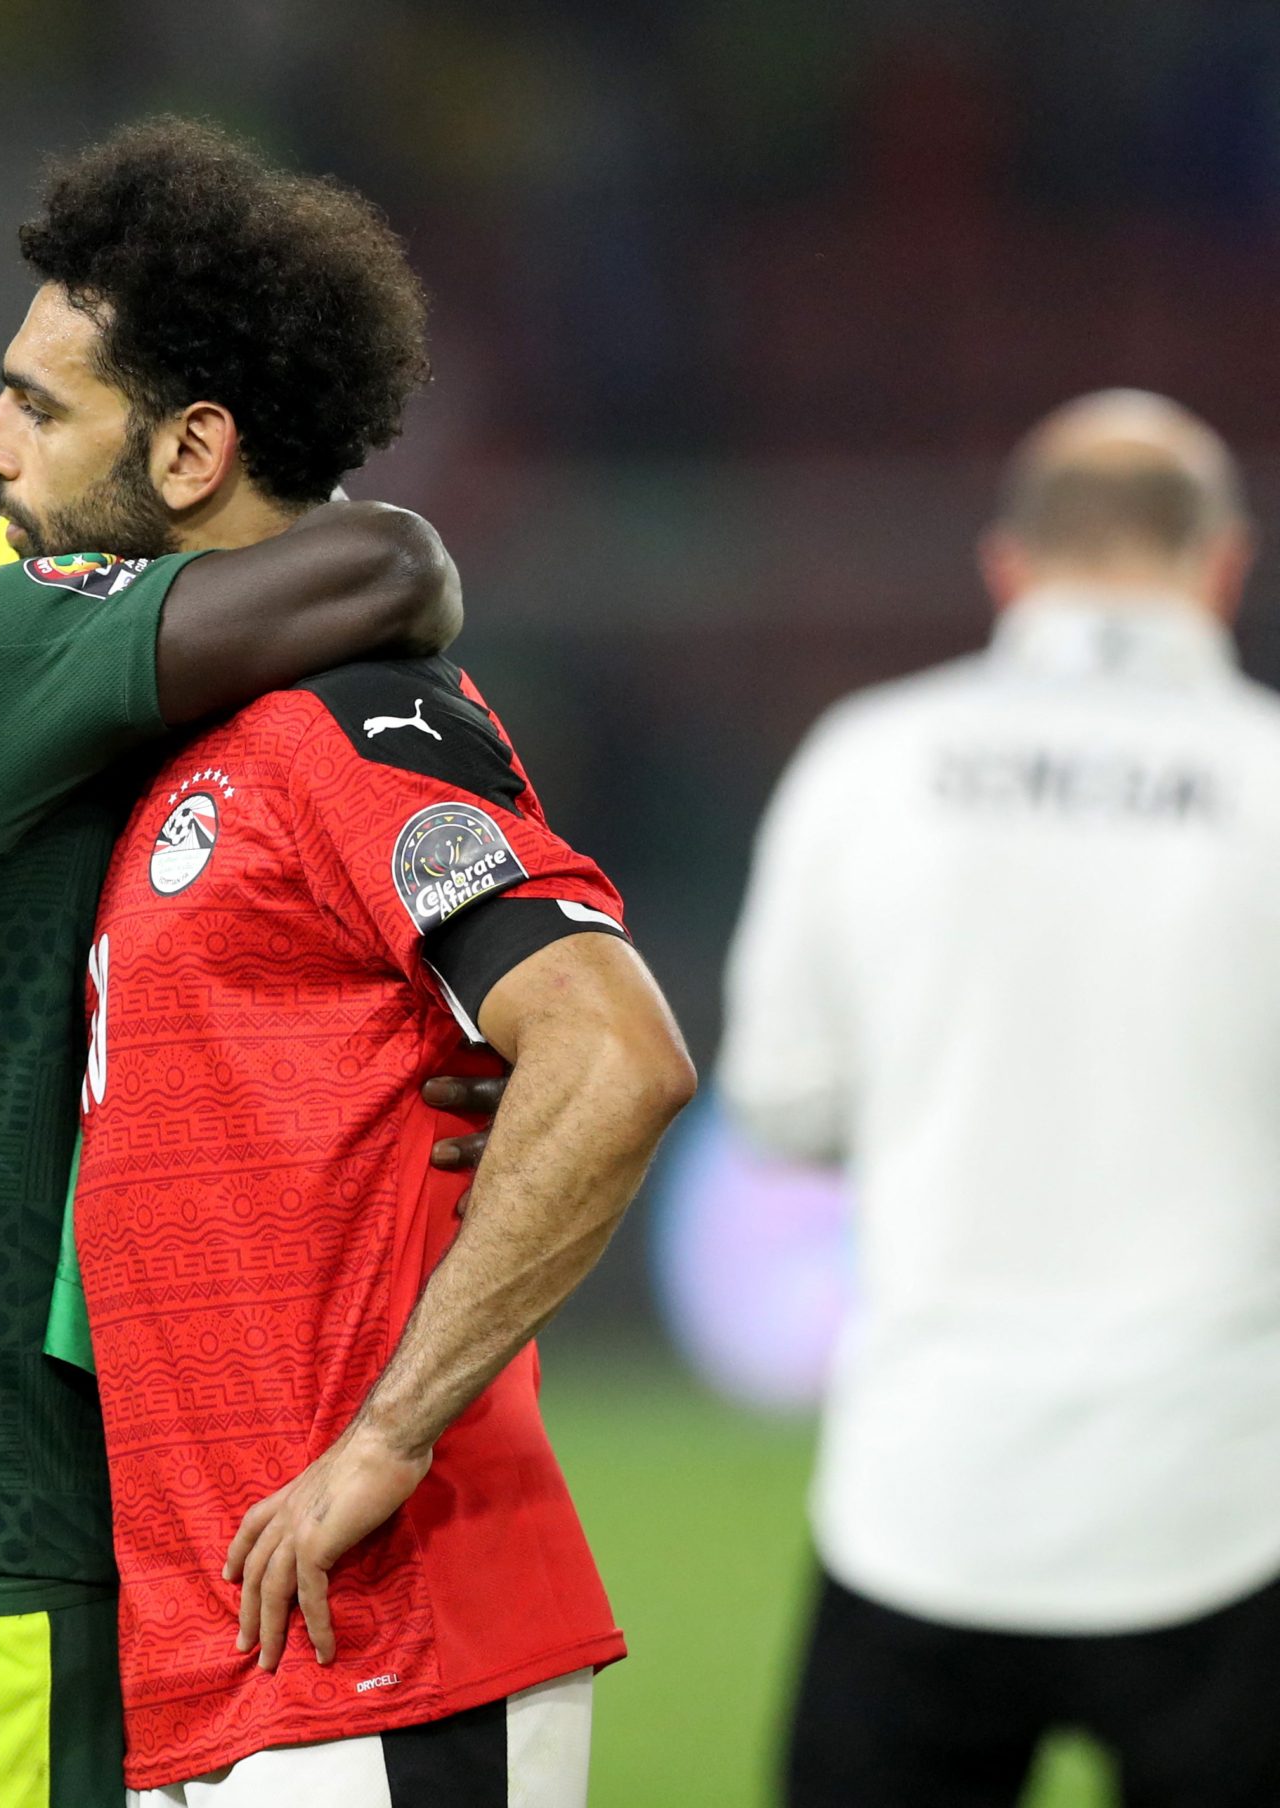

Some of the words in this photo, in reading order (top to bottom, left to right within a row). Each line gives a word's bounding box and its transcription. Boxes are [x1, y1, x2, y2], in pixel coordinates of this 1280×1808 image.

[416, 850, 507, 917] Celebrate
[439, 873, 495, 920] Africa
[356, 1673, 402, 1693] DRYCELL
